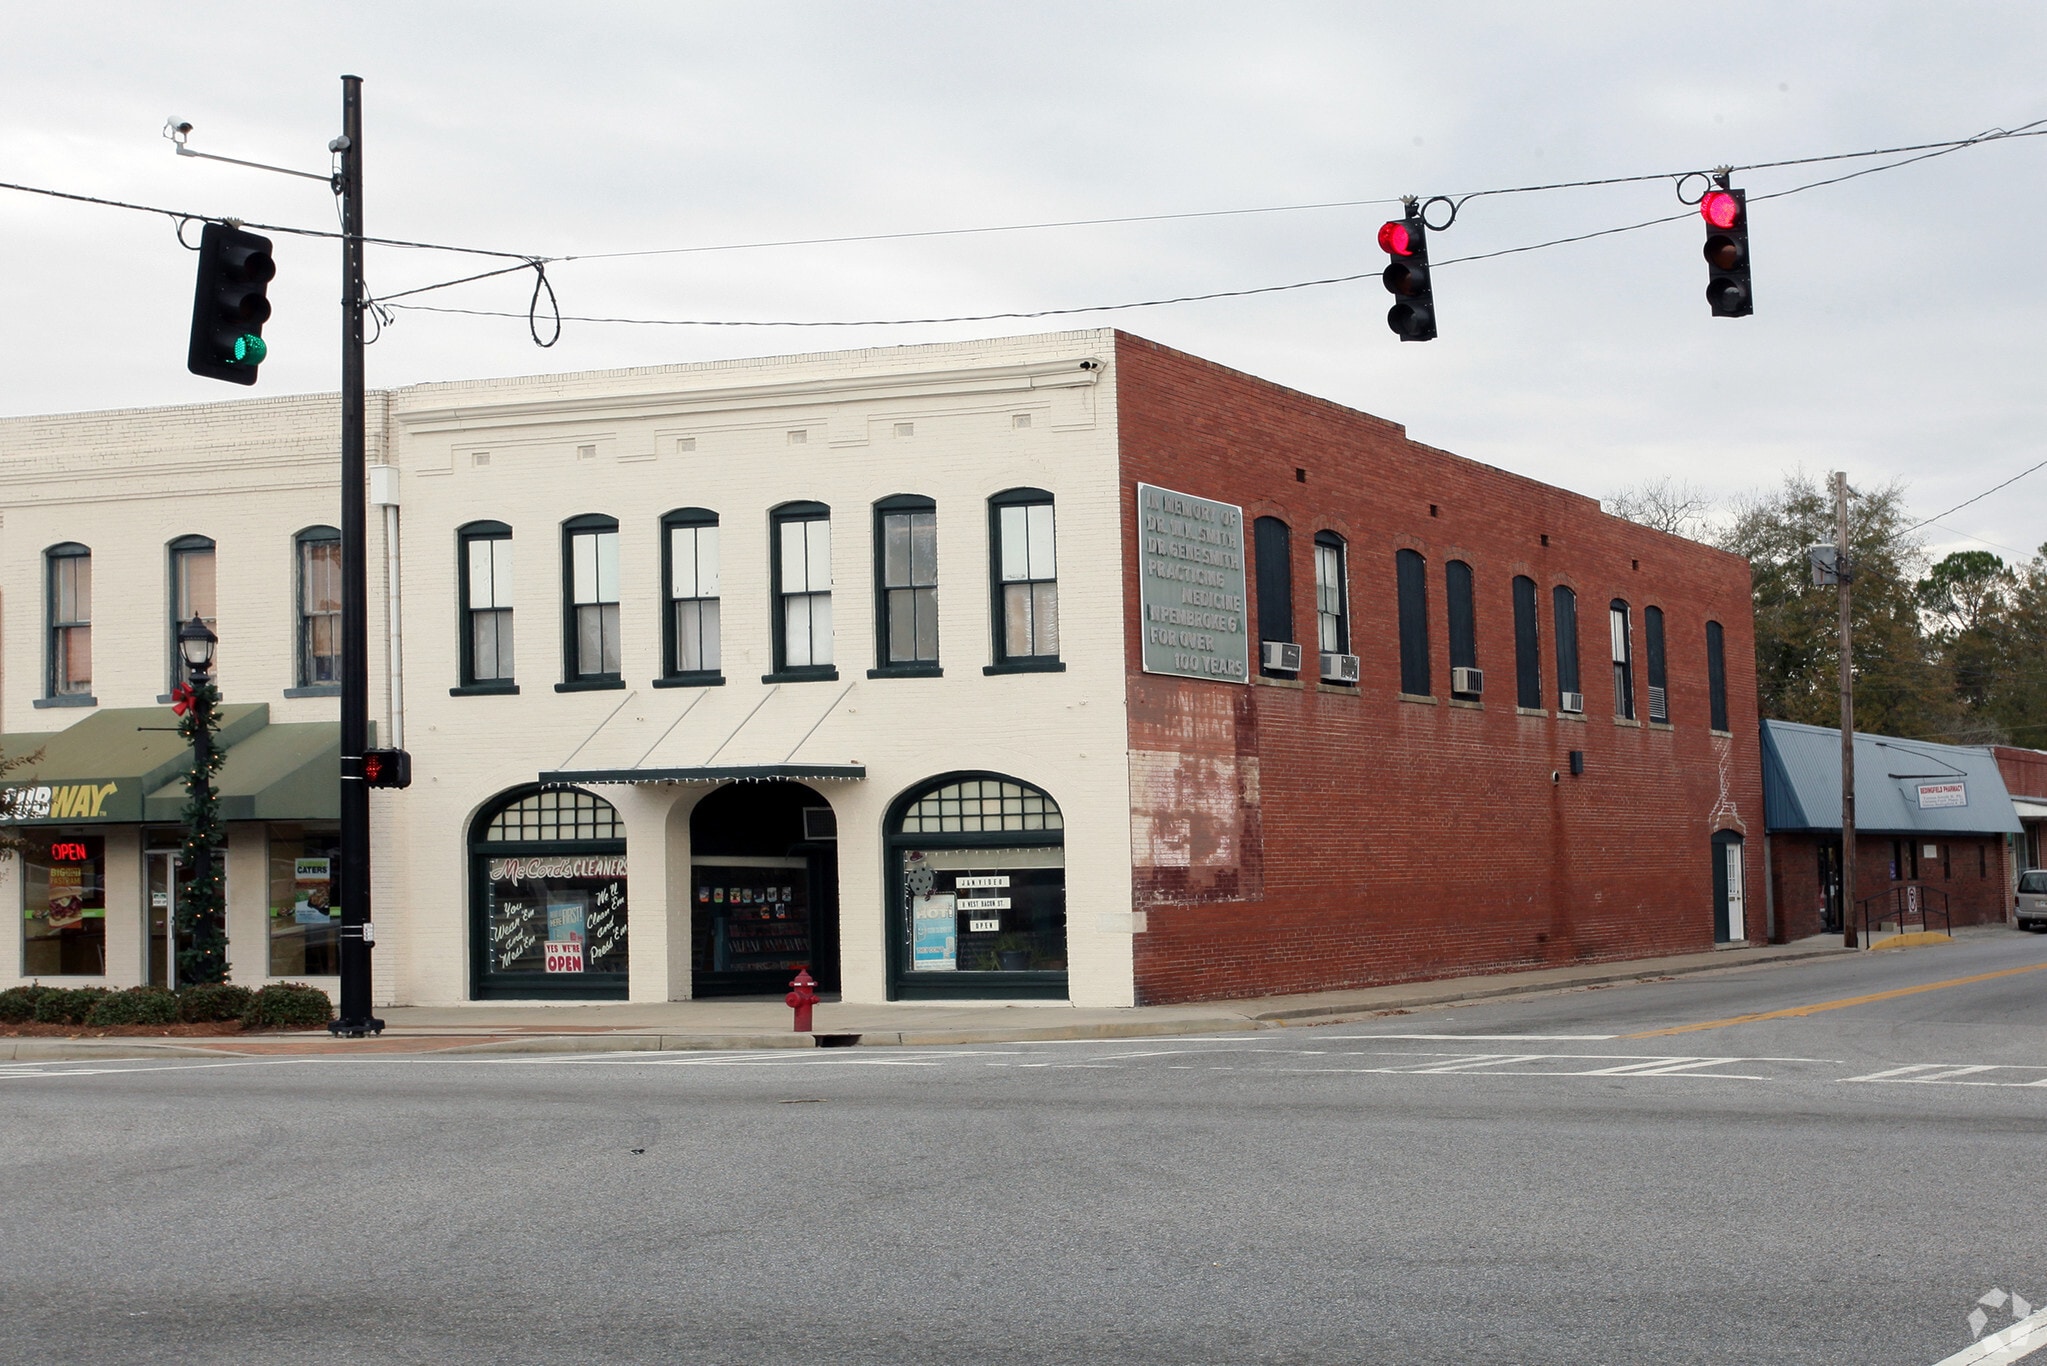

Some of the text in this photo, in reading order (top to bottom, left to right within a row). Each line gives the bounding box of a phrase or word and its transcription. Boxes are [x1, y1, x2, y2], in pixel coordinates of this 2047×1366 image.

[1146, 492, 1236, 527] IN MEMORY OF
[1199, 525, 1237, 550] SMITH
[1168, 541, 1201, 563] GENE
[1202, 547, 1240, 571] SMITH
[1148, 559, 1225, 589] PRACTICING
[1182, 587, 1241, 613] MEDICINE
[1160, 605, 1227, 633] PEMBROKE
[1150, 626, 1214, 652] FOR OVER
[1174, 652, 1244, 677] 100 YEARS
[51, 843, 87, 860] OPEN
[297, 866, 328, 874] CATERS
[490, 858, 574, 887] McCord's
[978, 878, 1002, 886] VIDEO
[503, 902, 522, 918] You
[586, 908, 610, 929] Clean
[493, 918, 521, 942] Wear
[505, 928, 524, 950] and
[596, 915, 615, 938] and
[499, 944, 524, 969] Mess
[546, 944, 580, 953] YES WE'RE
[590, 936, 614, 965] Press
[547, 955, 582, 972] OPEN
